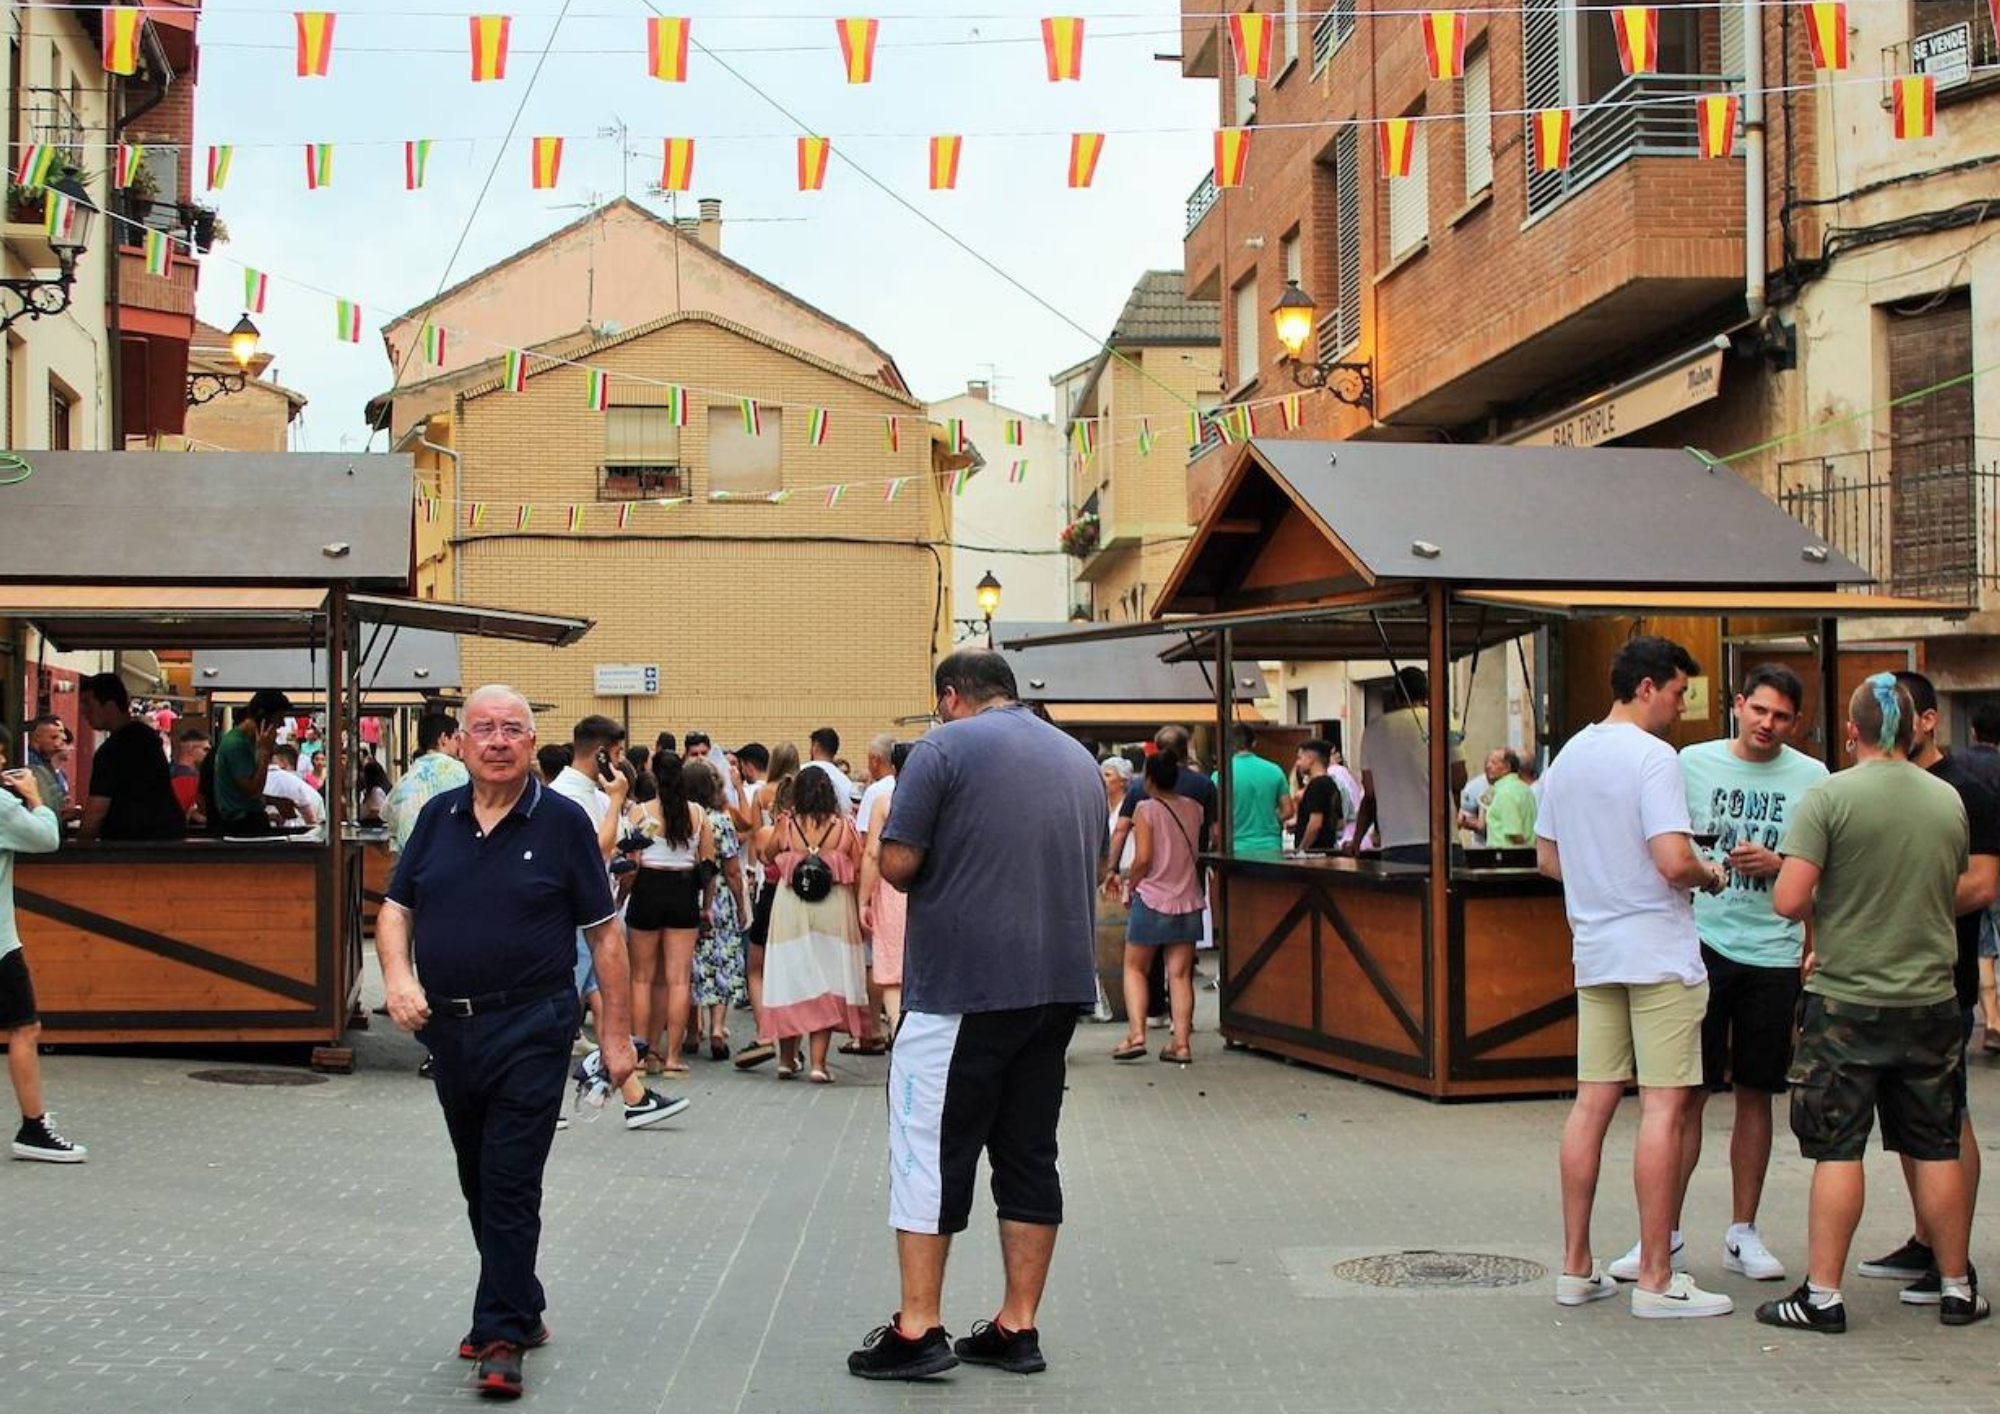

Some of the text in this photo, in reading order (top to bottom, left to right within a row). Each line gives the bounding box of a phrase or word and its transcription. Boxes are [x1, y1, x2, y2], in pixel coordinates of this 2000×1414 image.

[1913, 40, 1928, 60] SE
[1929, 28, 1966, 56] VENDE
[1553, 403, 1615, 447] BAR TRIPLE
[1711, 787, 1786, 823] COME
